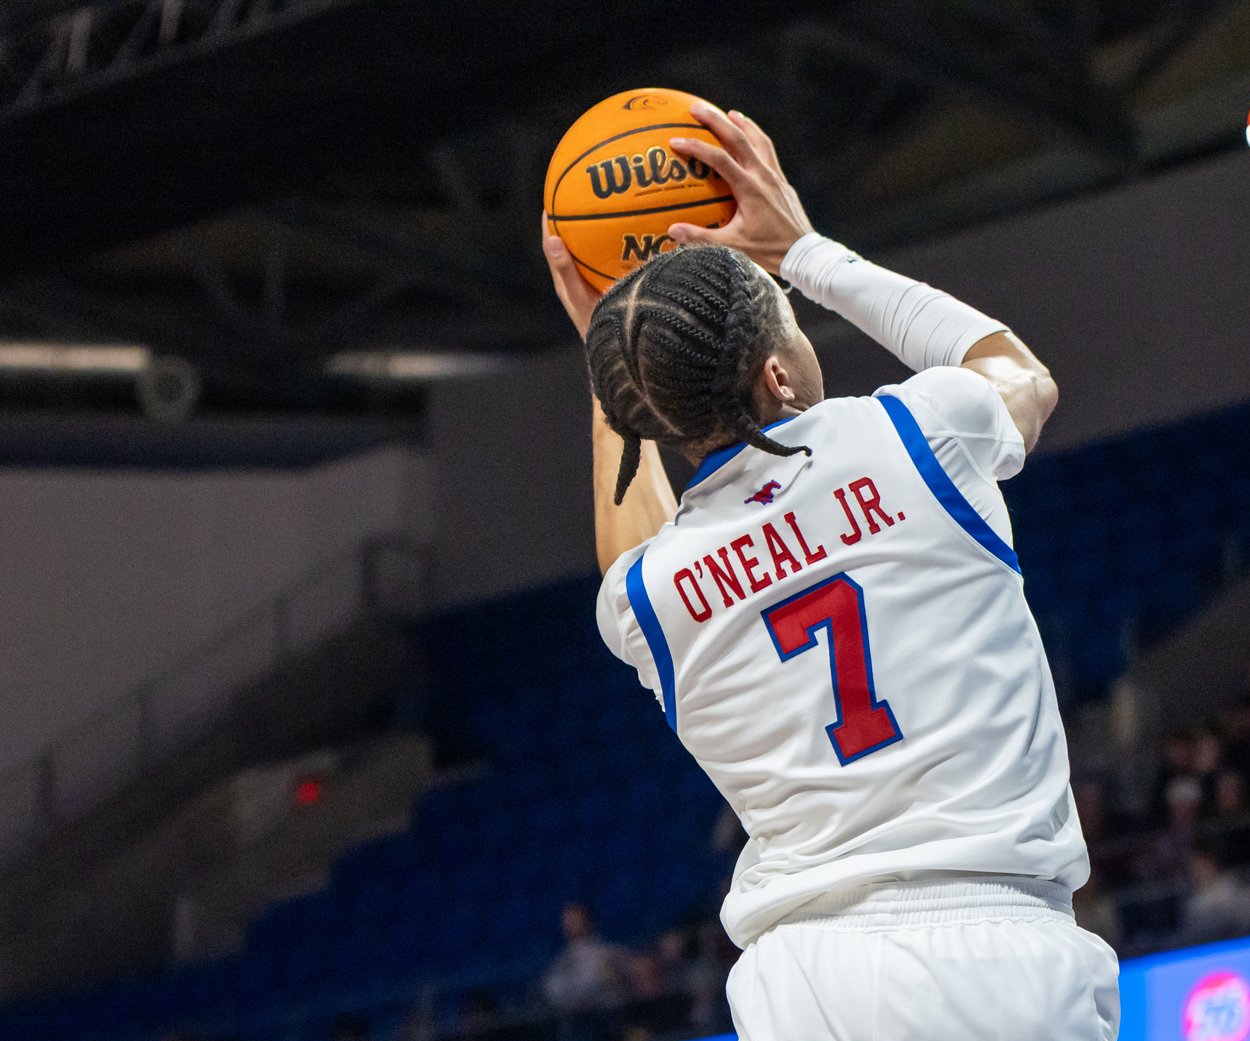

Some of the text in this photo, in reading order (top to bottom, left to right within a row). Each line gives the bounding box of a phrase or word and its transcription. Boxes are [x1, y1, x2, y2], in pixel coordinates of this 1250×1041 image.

[586, 147, 723, 199] Wilso
[673, 476, 906, 623] O'NEAL JR.
[760, 571, 904, 767] 7
